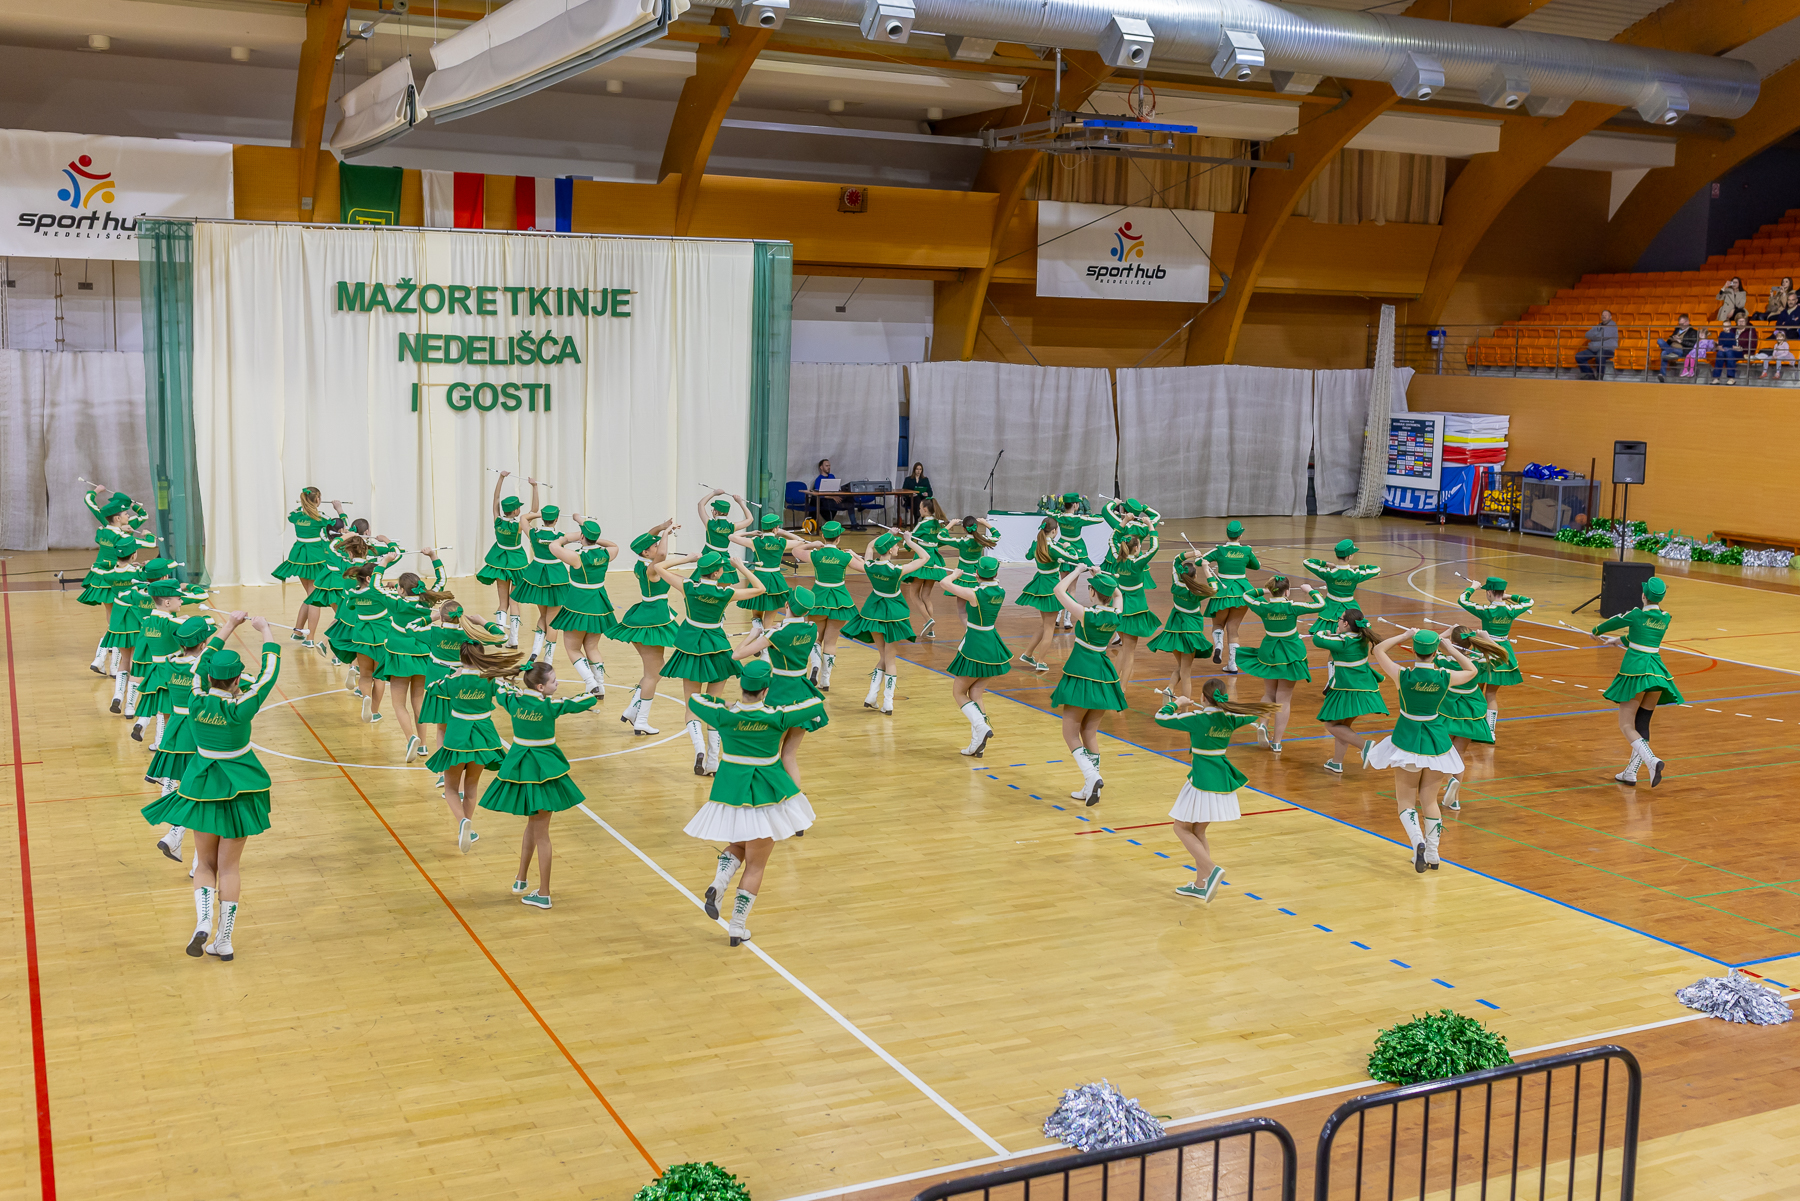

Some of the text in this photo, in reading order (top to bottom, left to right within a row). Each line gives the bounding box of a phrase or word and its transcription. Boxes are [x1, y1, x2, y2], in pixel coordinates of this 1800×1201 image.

[17, 210, 144, 233] sport hu
[1086, 263, 1166, 281] sport hub
[337, 277, 632, 318] MAŽORETKINJE
[398, 329, 582, 365] NEDELIŠĆA
[411, 381, 551, 412] I GOSTI
